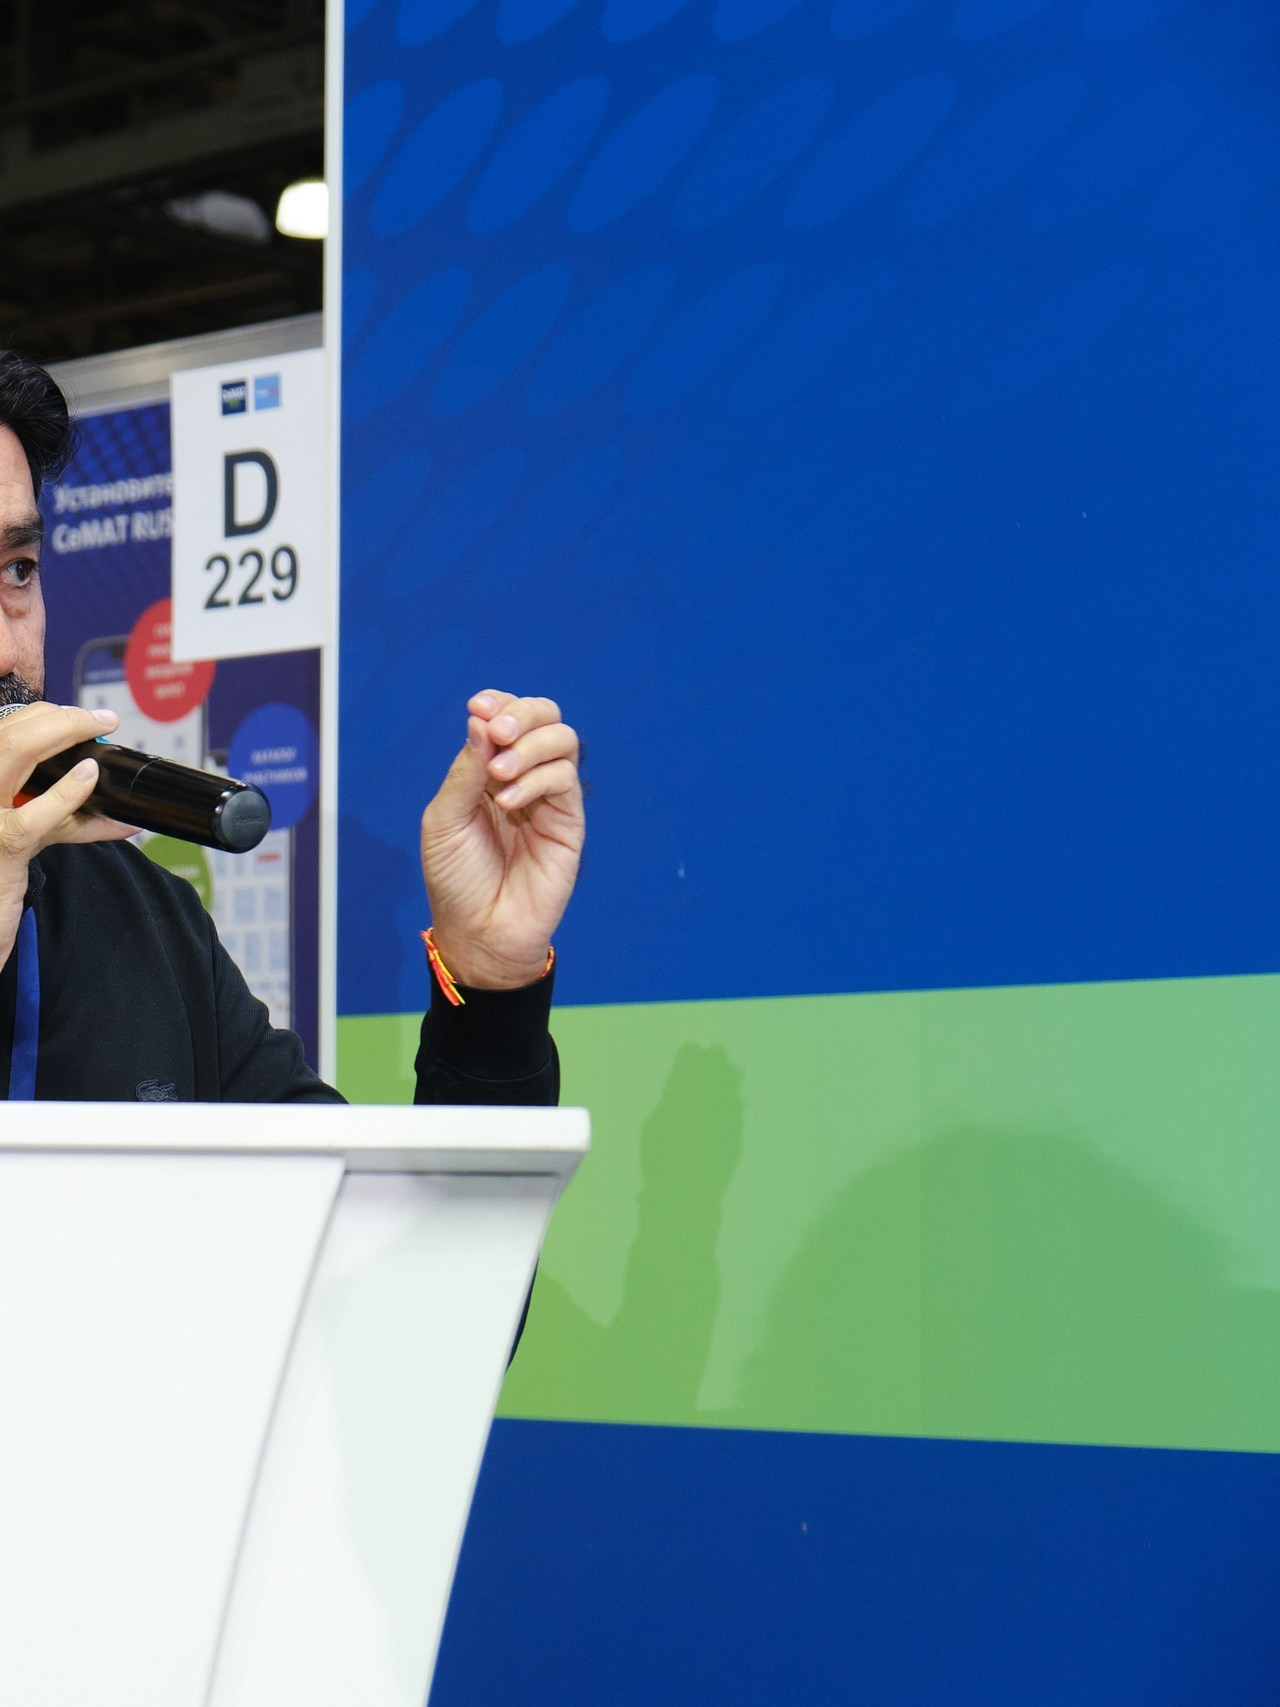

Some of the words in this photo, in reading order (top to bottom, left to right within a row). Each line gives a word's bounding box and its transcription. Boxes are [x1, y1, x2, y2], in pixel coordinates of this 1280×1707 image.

[224, 449, 279, 538] D
[52, 513, 129, 555] CeMAT
[204, 544, 299, 610] 229
